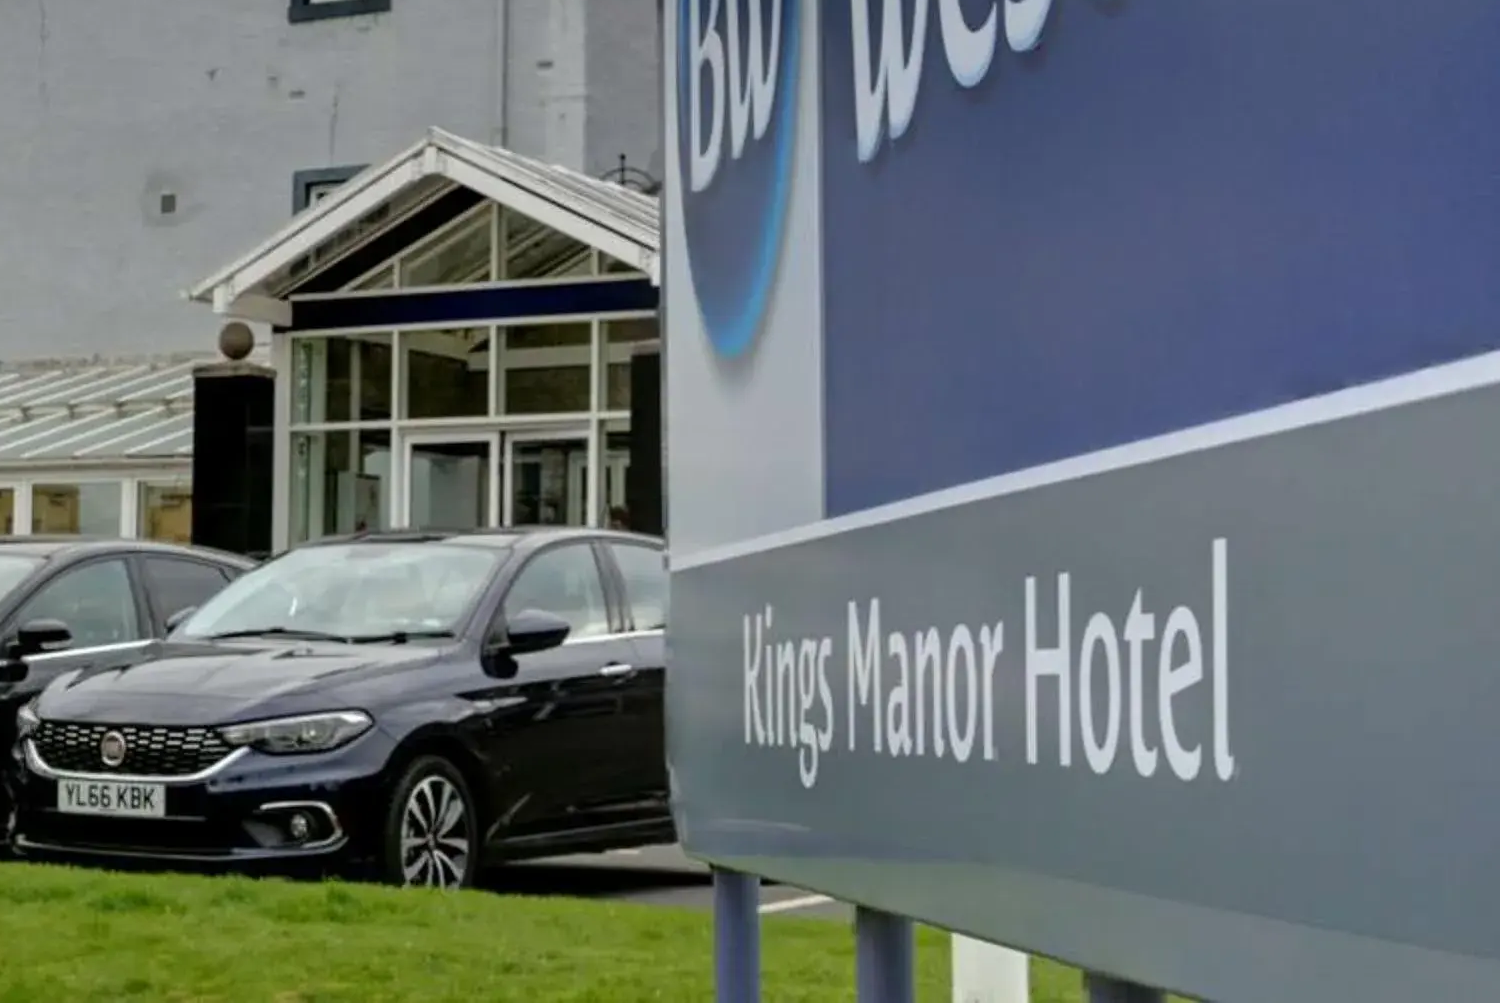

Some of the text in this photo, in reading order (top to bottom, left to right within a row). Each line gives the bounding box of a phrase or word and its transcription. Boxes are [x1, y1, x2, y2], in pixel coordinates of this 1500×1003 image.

[743, 538, 1235, 788] Kings Manor Hotel
[65, 783, 156, 811] YL66 KBK
